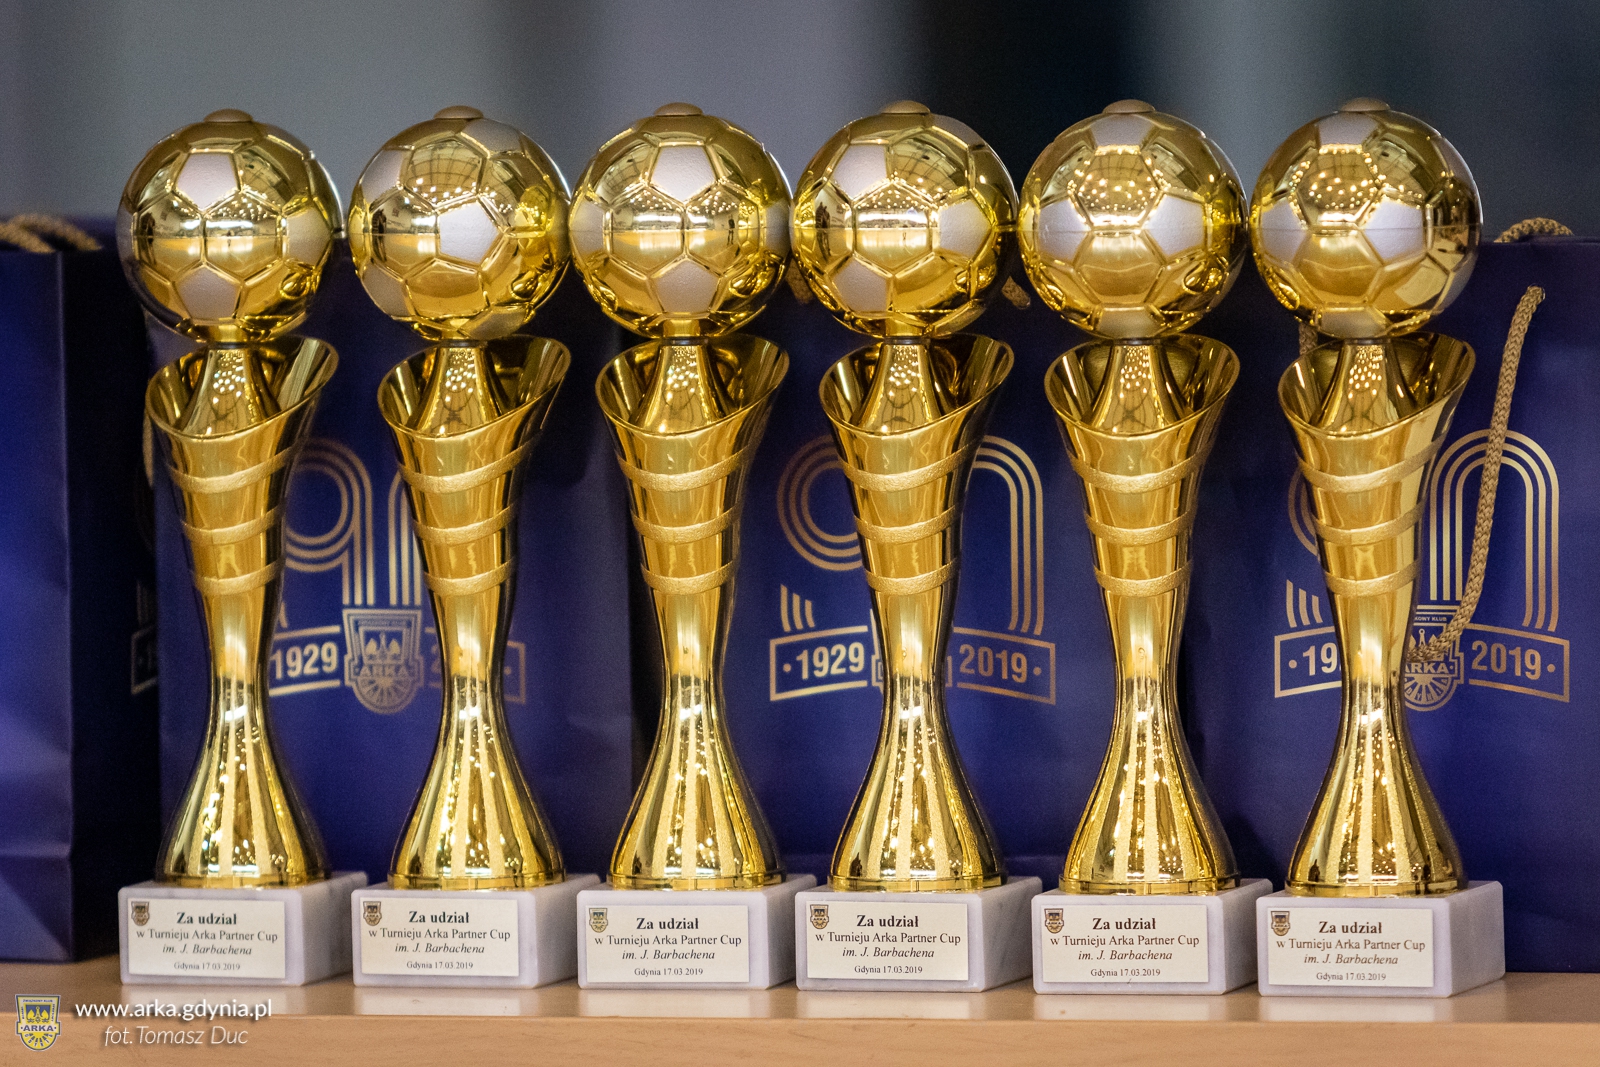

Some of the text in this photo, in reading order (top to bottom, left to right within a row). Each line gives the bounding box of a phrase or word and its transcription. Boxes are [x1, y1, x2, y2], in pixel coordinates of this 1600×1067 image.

[270, 641, 338, 680] 1929
[796, 641, 865, 680] 1929
[959, 643, 1028, 683] 2019
[1302, 642, 1341, 676] 19
[1471, 640, 1542, 681] 2019
[176, 911, 194, 925] Za
[408, 910, 470, 924] Za udział
[636, 917, 699, 930] Za udział
[856, 914, 919, 928] Za udział
[1092, 917, 1157, 931] Za udział
[368, 927, 512, 942] w Turnieju Arka Partner Cup
[1318, 920, 1383, 935] Za udział
[135, 928, 279, 944] w Turnieju Arka Partner Cup
[594, 934, 743, 948] w Turnieju Arka Partner Cup
[815, 931, 962, 946] w Turnieju Arka Partner Cup
[1050, 934, 1200, 949] w Turnieju Arka Partner Cup
[162, 943, 253, 956] im. J. Barbachena
[394, 942, 486, 954] im. J. Barbachena
[842, 946, 935, 958] im. J. Barbachena
[1276, 938, 1426, 953] w Turnieju Arka Partner Cup
[621, 949, 716, 960] im. J. Barbachena
[1077, 949, 1173, 961] im. J. Barbachena
[1303, 953, 1400, 965] im. J. Barbachena
[173, 961, 200, 972] Gdynia
[406, 960, 475, 971] Gdynia 17.03.2019
[633, 967, 704, 978] Gdynia 17.03.2019
[854, 965, 923, 975] Gdynia 17.03.2019
[1090, 968, 1161, 979] Gdynia 17.03.2019
[1315, 971, 1388, 982] Gdynia 17.03.2019
